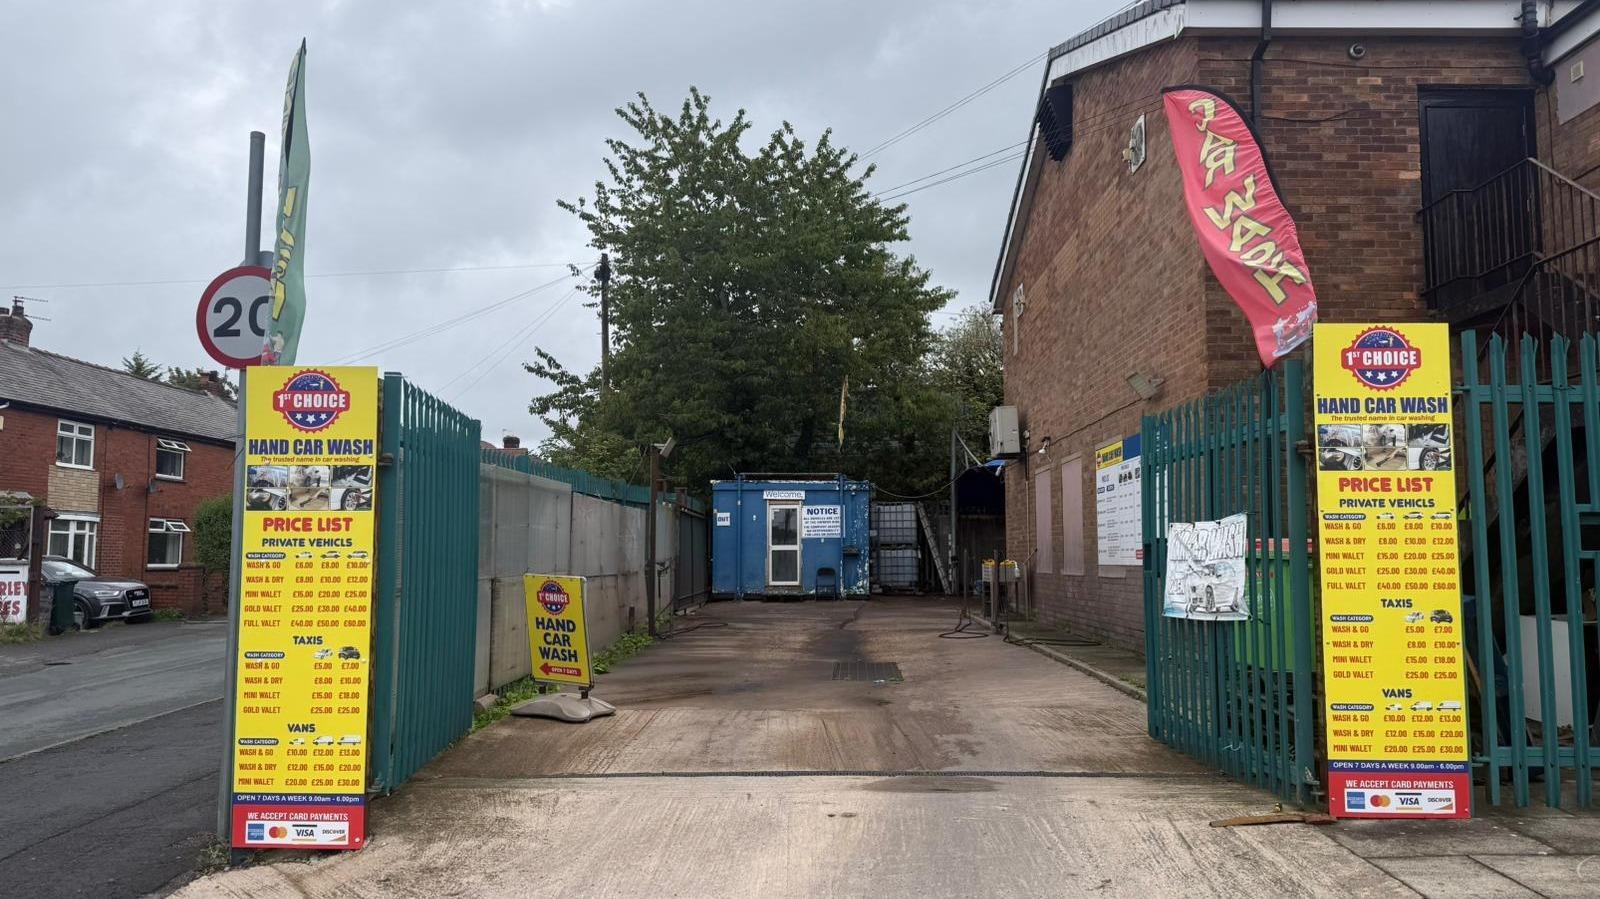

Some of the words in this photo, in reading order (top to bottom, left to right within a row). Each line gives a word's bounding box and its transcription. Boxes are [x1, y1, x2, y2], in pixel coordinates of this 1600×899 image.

[213, 296, 271, 337] 20
[1346, 351, 1360, 366] 1ST
[1363, 351, 1417, 366] CHOICE
[277, 393, 292, 409] 1ST
[293, 393, 346, 409] CHOICE
[1318, 397, 1360, 414] HAND
[1364, 397, 1396, 414] CAR
[1400, 397, 1448, 414] WASH
[248, 438, 289, 455] HAND
[293, 438, 323, 455] CAR
[327, 438, 373, 455] WASH
[1339, 478, 1391, 492] PRICE
[1396, 478, 1433, 492] LIST
[1339, 498, 1385, 508] PRIVATE
[1389, 498, 1435, 508] VEHICLS
[806, 507, 839, 515] NOTICE
[263, 517, 314, 532] PRICE
[317, 517, 353, 532] LIST
[1324, 523, 1343, 531] WASH
[1344, 523, 1351, 531] &
[1351, 523, 1361, 531] GO
[262, 538, 305, 547] PRIVATE
[308, 538, 353, 547] VEHICLS
[1325, 552, 1340, 560] MINI
[1341, 552, 1364, 560] WALET
[246, 561, 264, 569] WASH
[264, 561, 270, 569] &
[271, 561, 281, 569] GO
[1326, 567, 1342, 575] GOLD
[1344, 567, 1366, 575] VALET
[1327, 582, 1343, 590] FULL
[1344, 582, 1366, 590] VALET
[545, 593, 569, 603] CHOICE
[1380, 598, 1413, 608] TAXIS
[535, 617, 576, 633] HAND
[293, 636, 323, 645] TAXIS
[543, 632, 571, 647] CAR
[538, 646, 578, 663] WASH
[1333, 656, 1347, 664] MINI
[1349, 656, 1372, 664] WALET
[1333, 671, 1349, 679] GOLD
[1351, 671, 1373, 679] VALET
[1382, 689, 1412, 698] VANS
[1332, 715, 1351, 723] WASH
[1352, 715, 1359, 723] &
[1360, 715, 1369, 723] GO
[287, 724, 315, 733] VANS
[1333, 729, 1352, 738] WASH
[1353, 729, 1359, 738] &
[1361, 729, 1374, 738] DRY
[1333, 744, 1348, 753] MINI
[1349, 744, 1372, 753] WALET
[1333, 762, 1353, 770] OPEN
[1361, 762, 1380, 770] DAYS
[1381, 762, 1386, 770] A
[1387, 762, 1409, 770] WEEK
[1346, 780, 1359, 789] WE
[1360, 780, 1389, 789] ACCEPT
[1391, 780, 1411, 789] CARD
[1413, 780, 1454, 789] PAYMENTS
[1399, 797, 1419, 806] VISA
[248, 812, 260, 821] WE
[261, 812, 288, 821] ACCEPT
[289, 812, 308, 821] CARD
[310, 812, 348, 821] PAYMENTS
[295, 829, 314, 838] VISA
